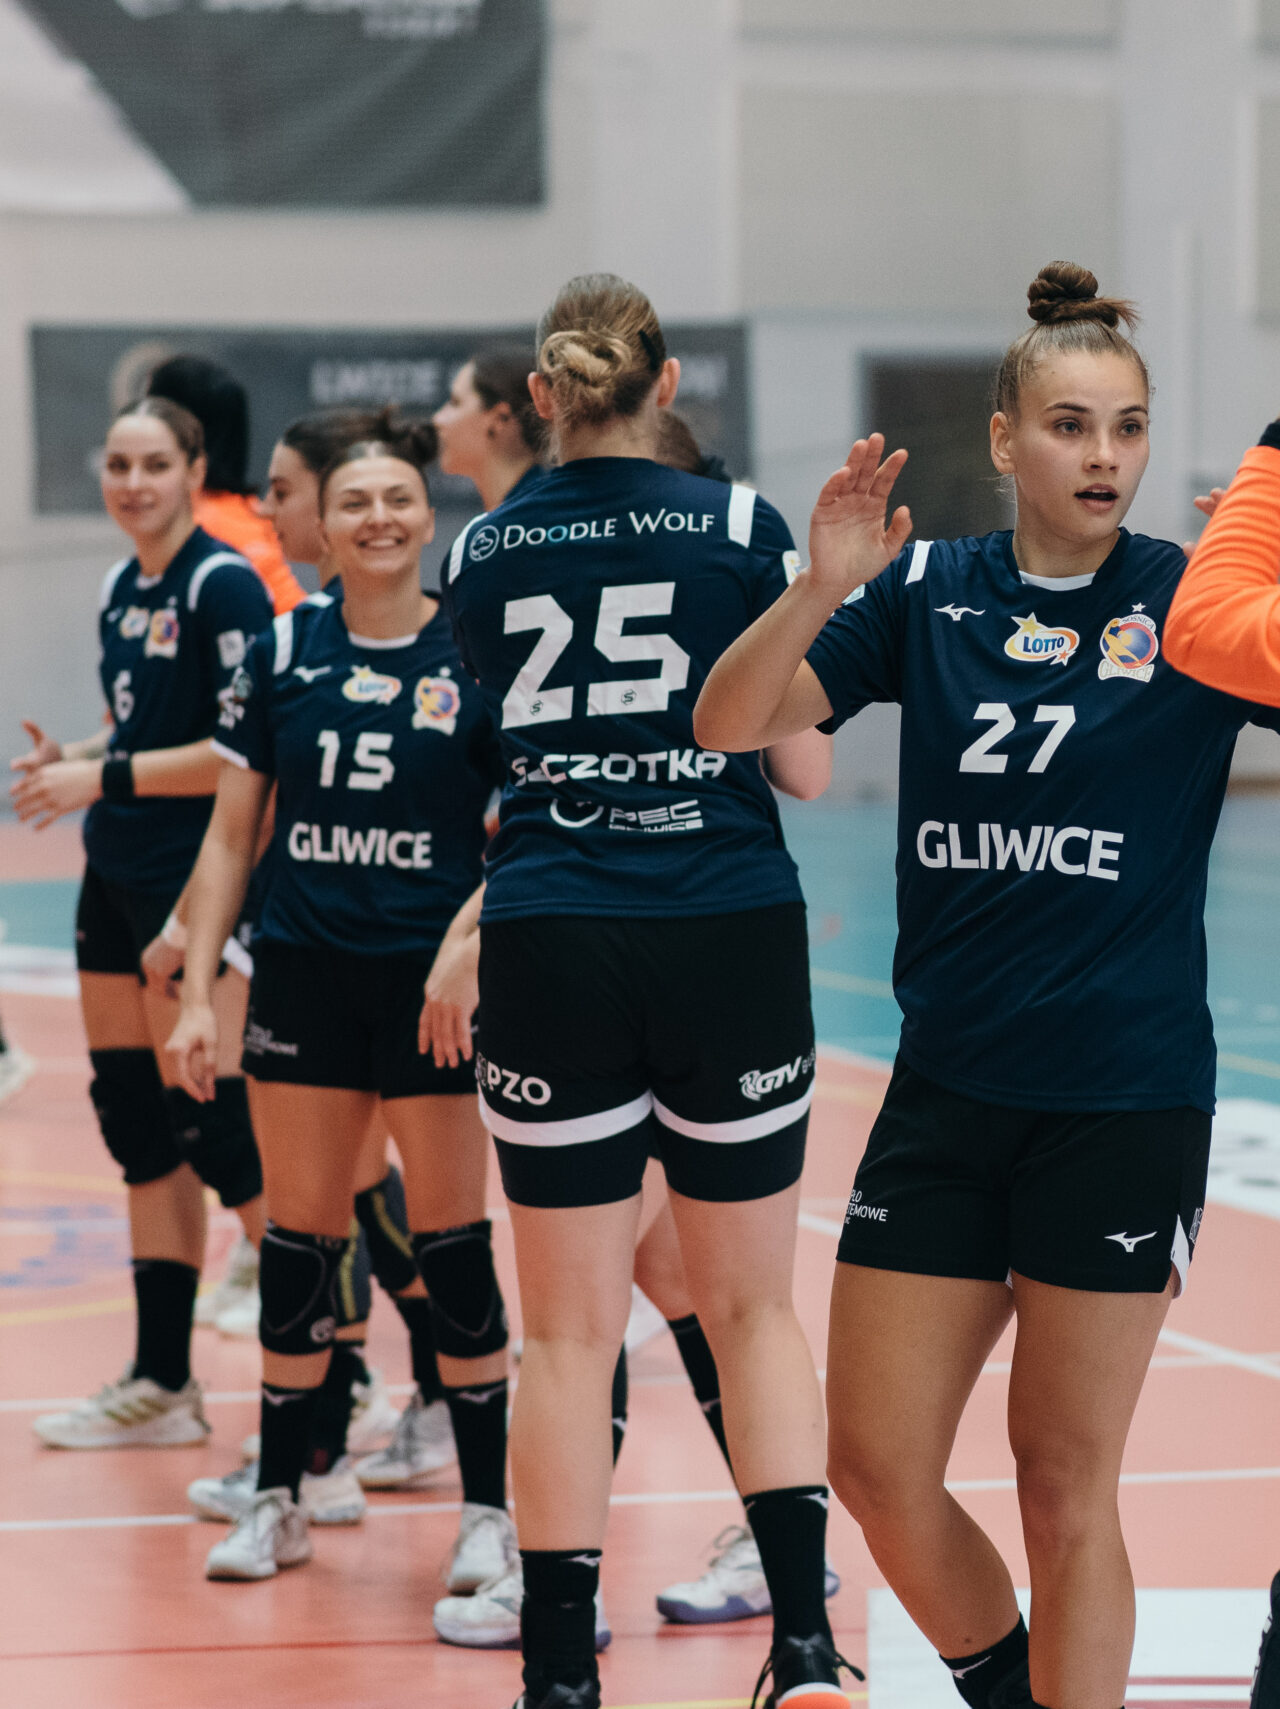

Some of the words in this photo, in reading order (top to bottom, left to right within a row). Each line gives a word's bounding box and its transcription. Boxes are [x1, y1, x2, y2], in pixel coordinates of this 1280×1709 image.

[629, 508, 715, 535] WOLF
[501, 581, 691, 730] 25
[1023, 635, 1065, 653] LOTTO
[114, 669, 135, 723] 6
[317, 729, 395, 790] 15
[959, 702, 1076, 773] 27
[288, 821, 432, 869] GLIWICE
[916, 820, 1124, 882] GLIWICE
[487, 1061, 551, 1106] PZO
